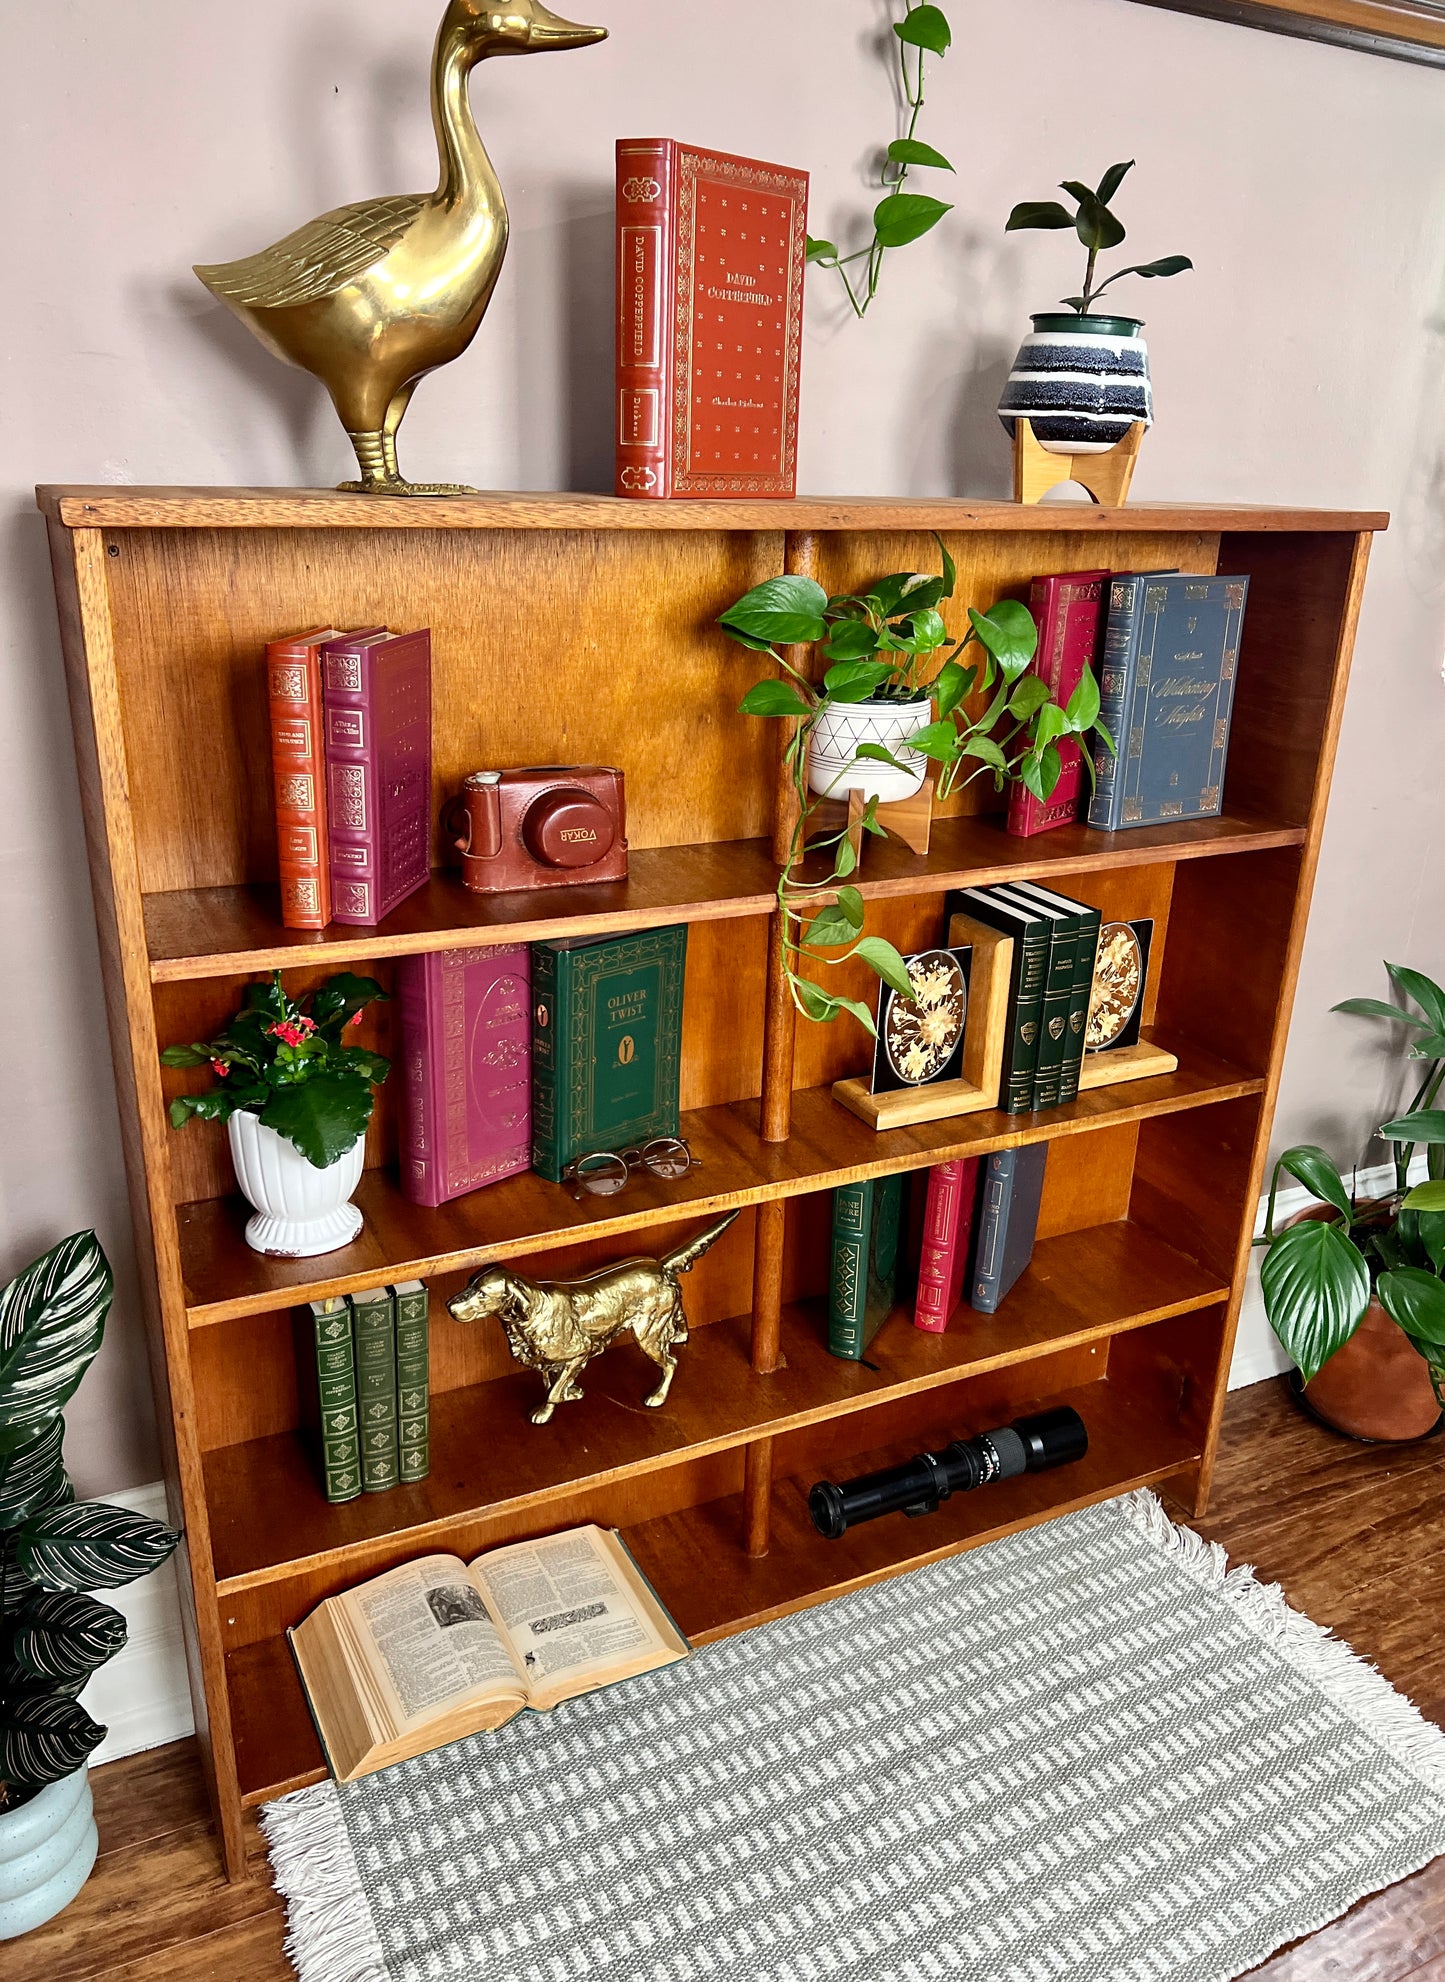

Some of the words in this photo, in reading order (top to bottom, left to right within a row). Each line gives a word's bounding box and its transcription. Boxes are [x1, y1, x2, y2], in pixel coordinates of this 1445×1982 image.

[635, 236, 645, 273] DAVID
[726, 271, 757, 288] DAVID
[707, 286, 774, 306] COPPERFIELD
[634, 277, 644, 356] COPPERFIELD
[633, 397, 641, 437] Dickens
[560, 828, 597, 842] VOKAR
[607, 989, 647, 1010] OLIVER
[610, 1003, 645, 1022] TWIST
